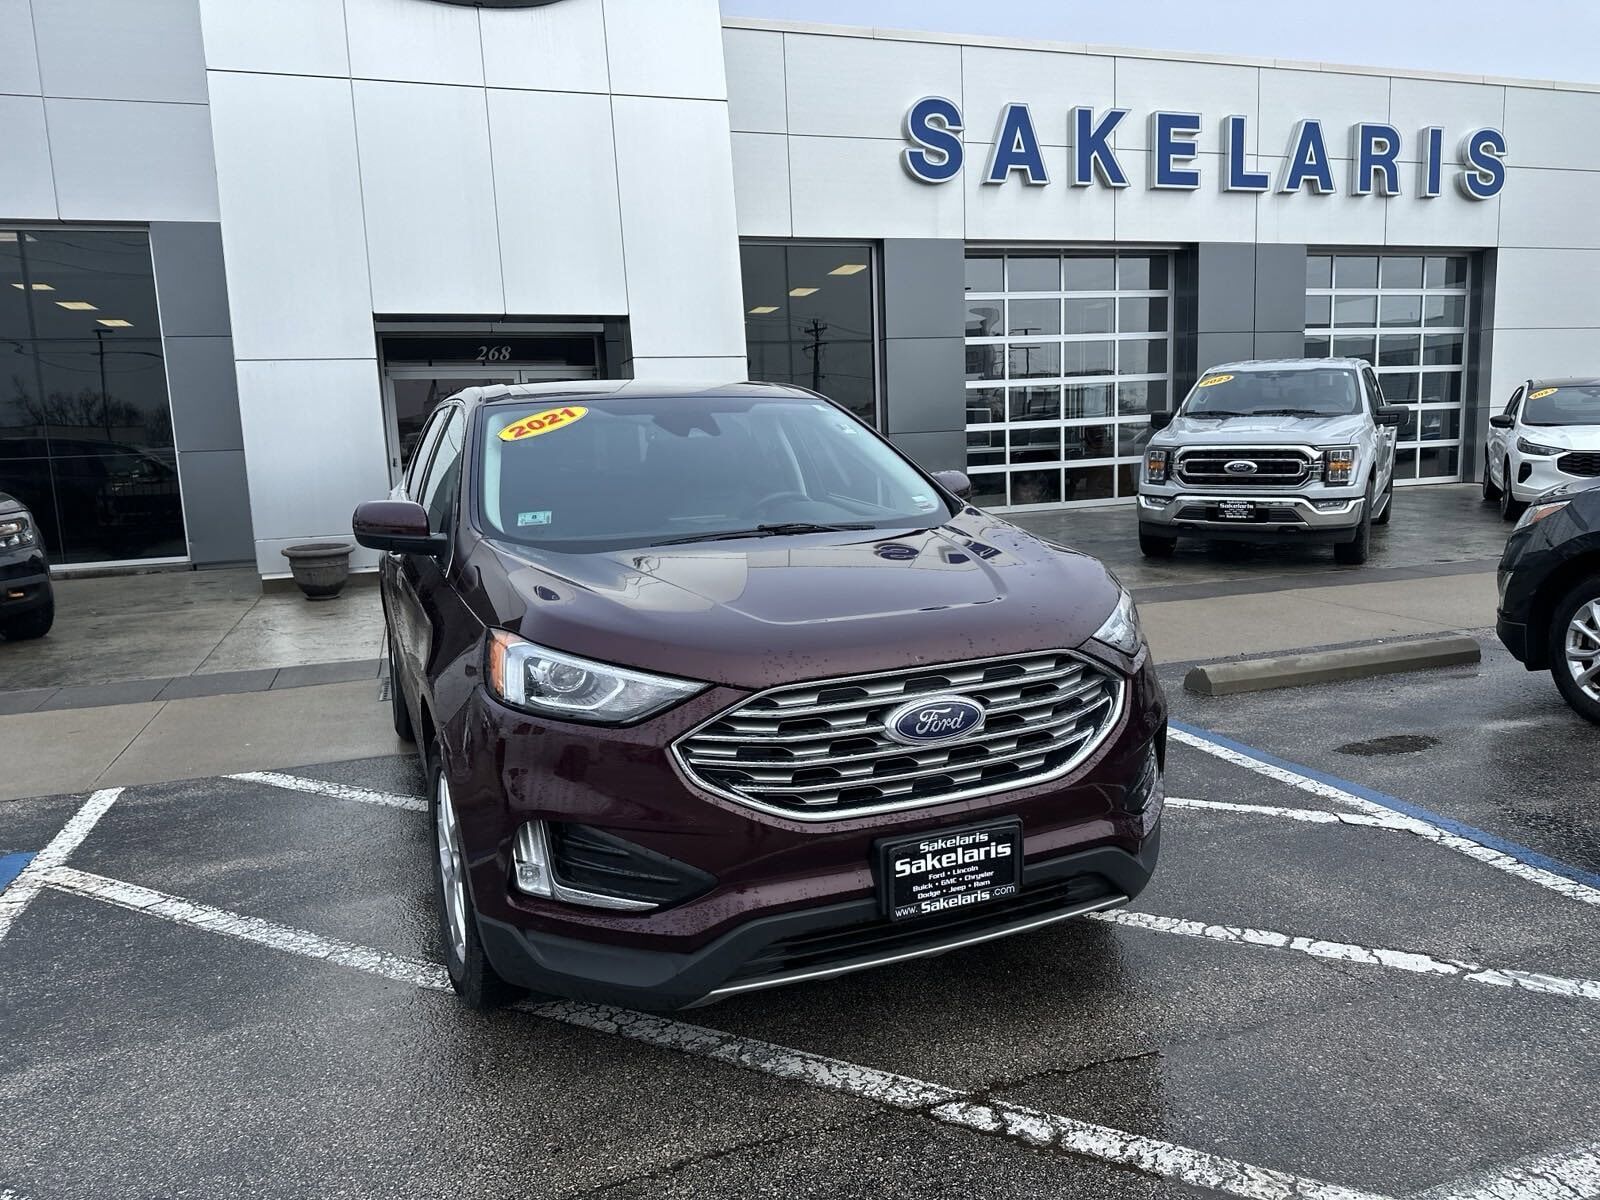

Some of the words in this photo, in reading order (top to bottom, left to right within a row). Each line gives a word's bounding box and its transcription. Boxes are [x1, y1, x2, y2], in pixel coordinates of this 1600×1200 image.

[902, 96, 1507, 199] SAKELARIS
[475, 345, 512, 361] 268
[508, 408, 576, 438] 2021
[915, 707, 965, 734] Ford
[919, 832, 989, 853] Sakelaris
[895, 842, 1011, 877] Sakelaris
[912, 882, 933, 892] Buick
[940, 877, 957, 886] GMC
[964, 870, 994, 881] Chrysler
[928, 871, 945, 880] Ford
[952, 865, 978, 875] Lincoln
[917, 889, 941, 899] Dodge
[949, 884, 967, 893] Jeep
[973, 879, 991, 887] Ram
